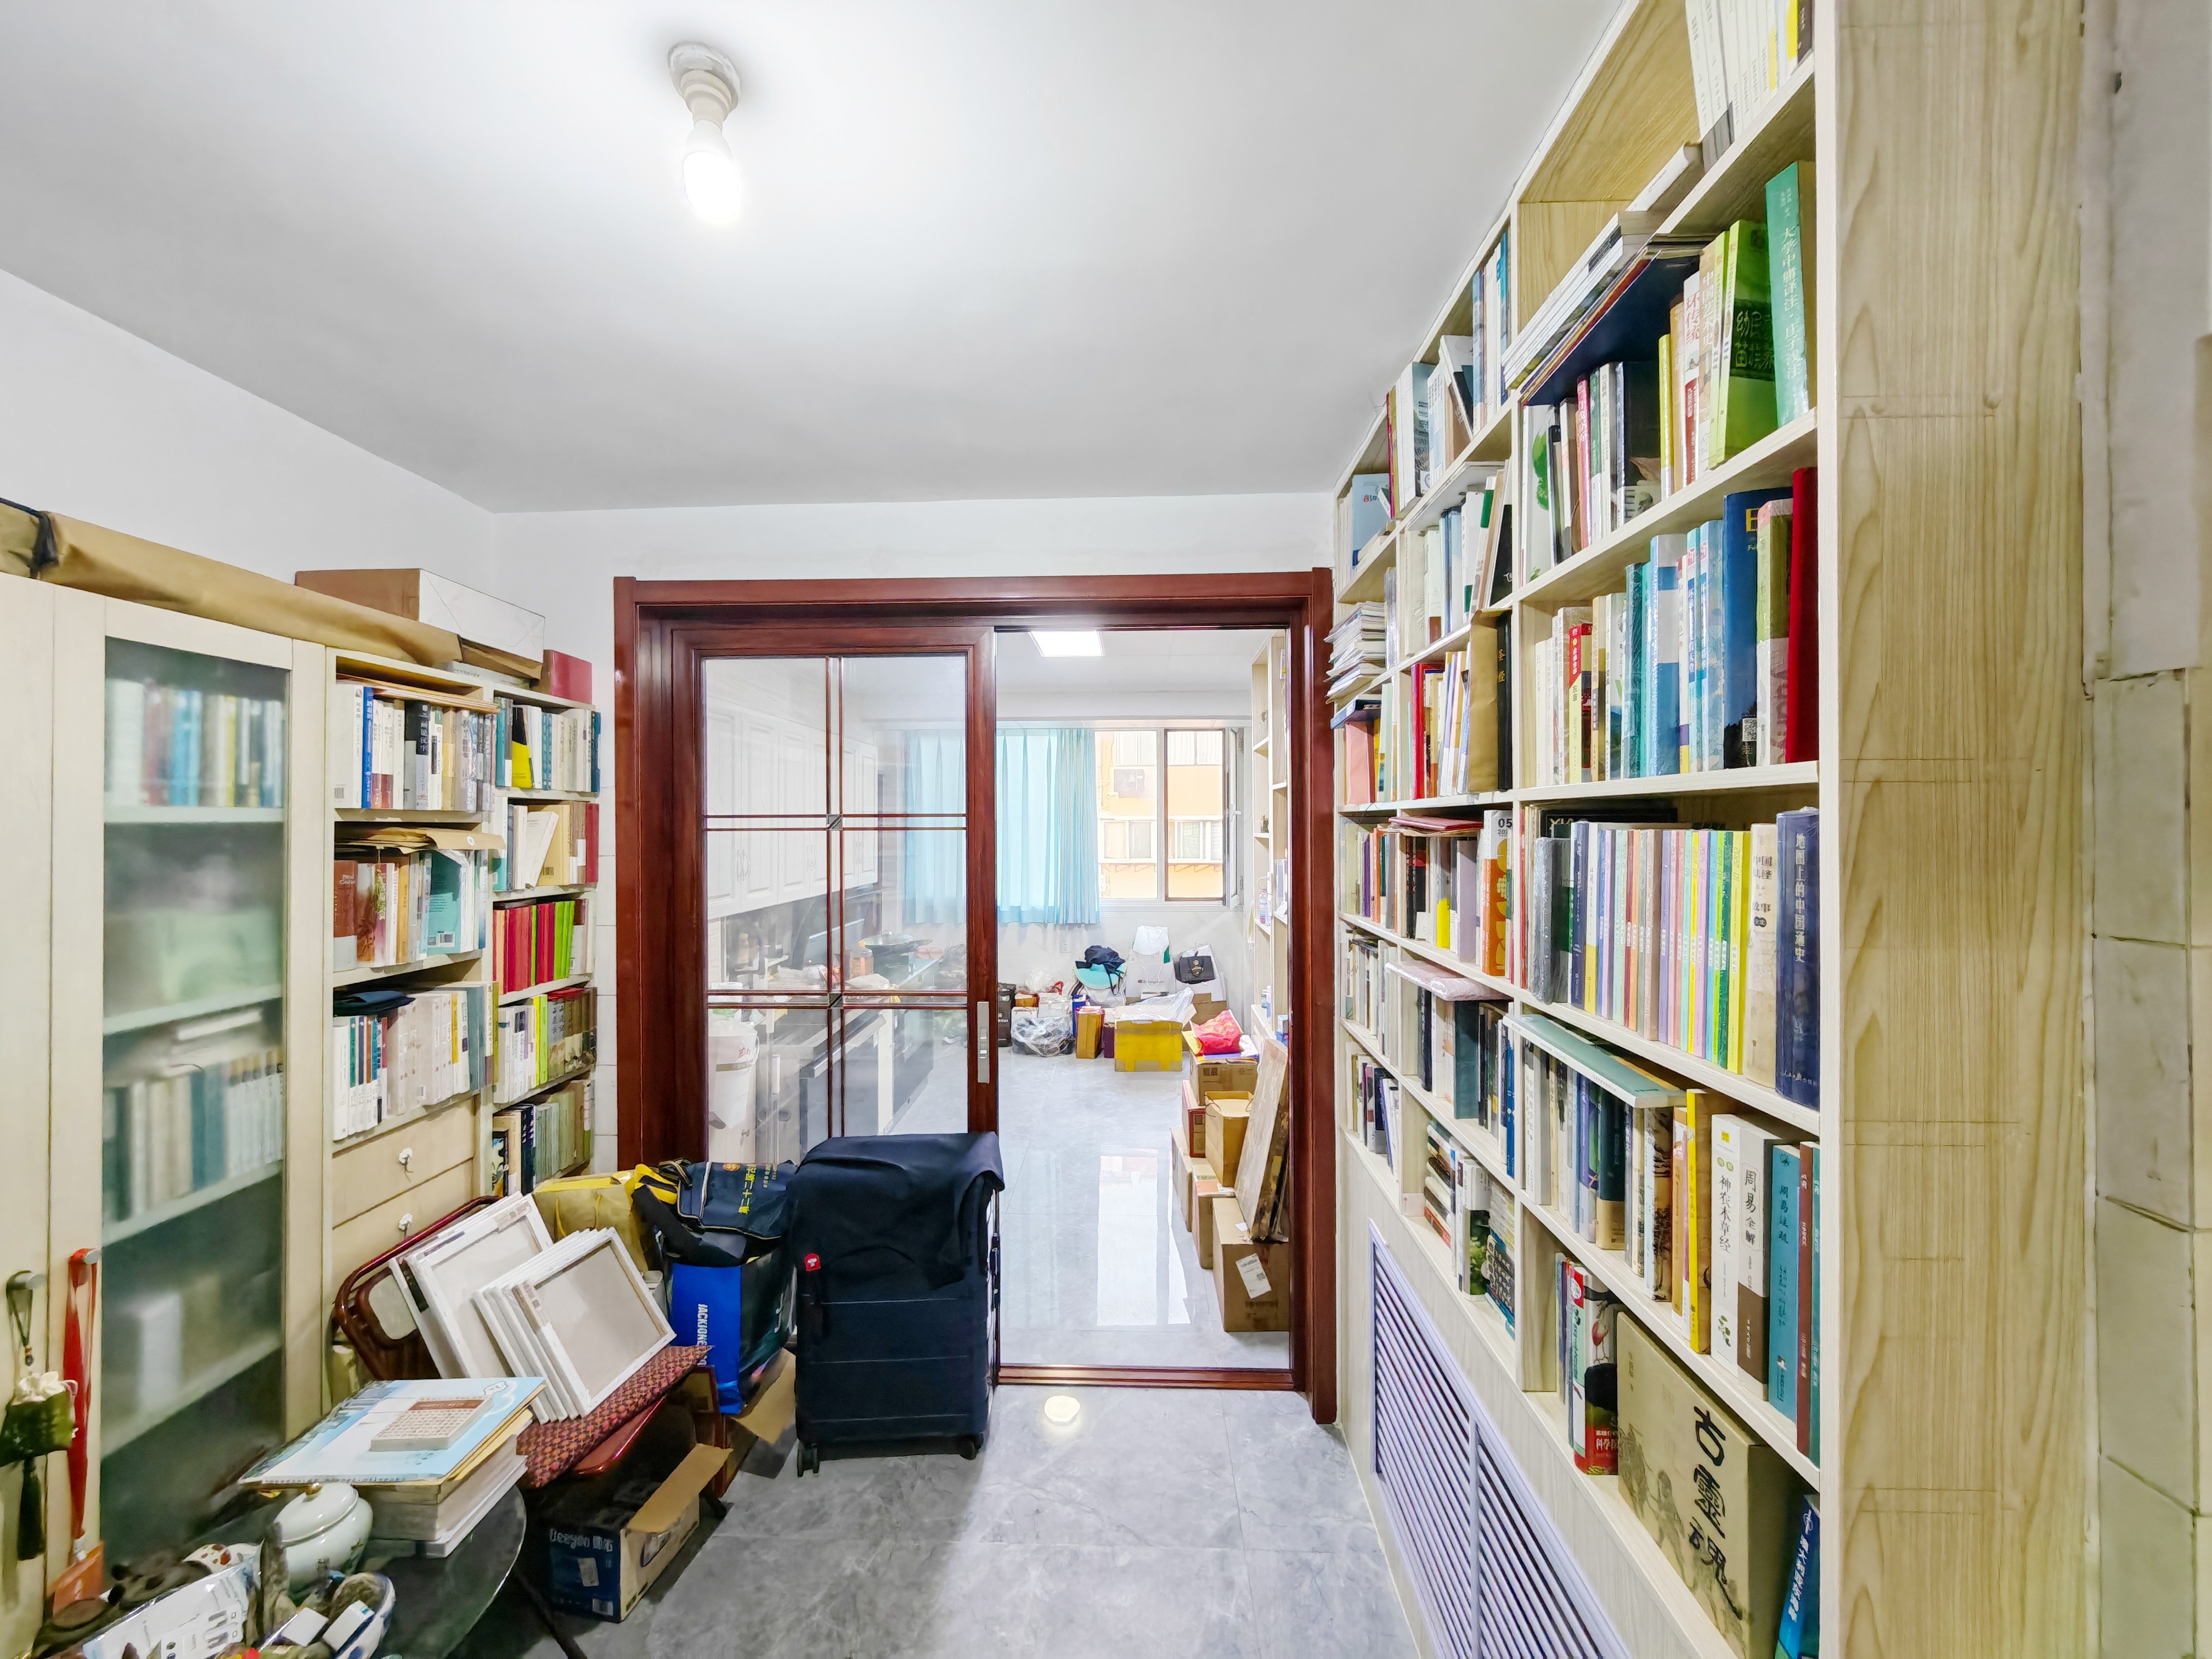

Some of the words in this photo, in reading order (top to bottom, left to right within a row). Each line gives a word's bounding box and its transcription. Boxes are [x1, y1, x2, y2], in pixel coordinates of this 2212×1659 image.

[1498, 818, 1512, 828] 05
[1795, 833, 1805, 963] 地图上的中国通史
[738, 1164, 757, 1215] 第二十二届古
